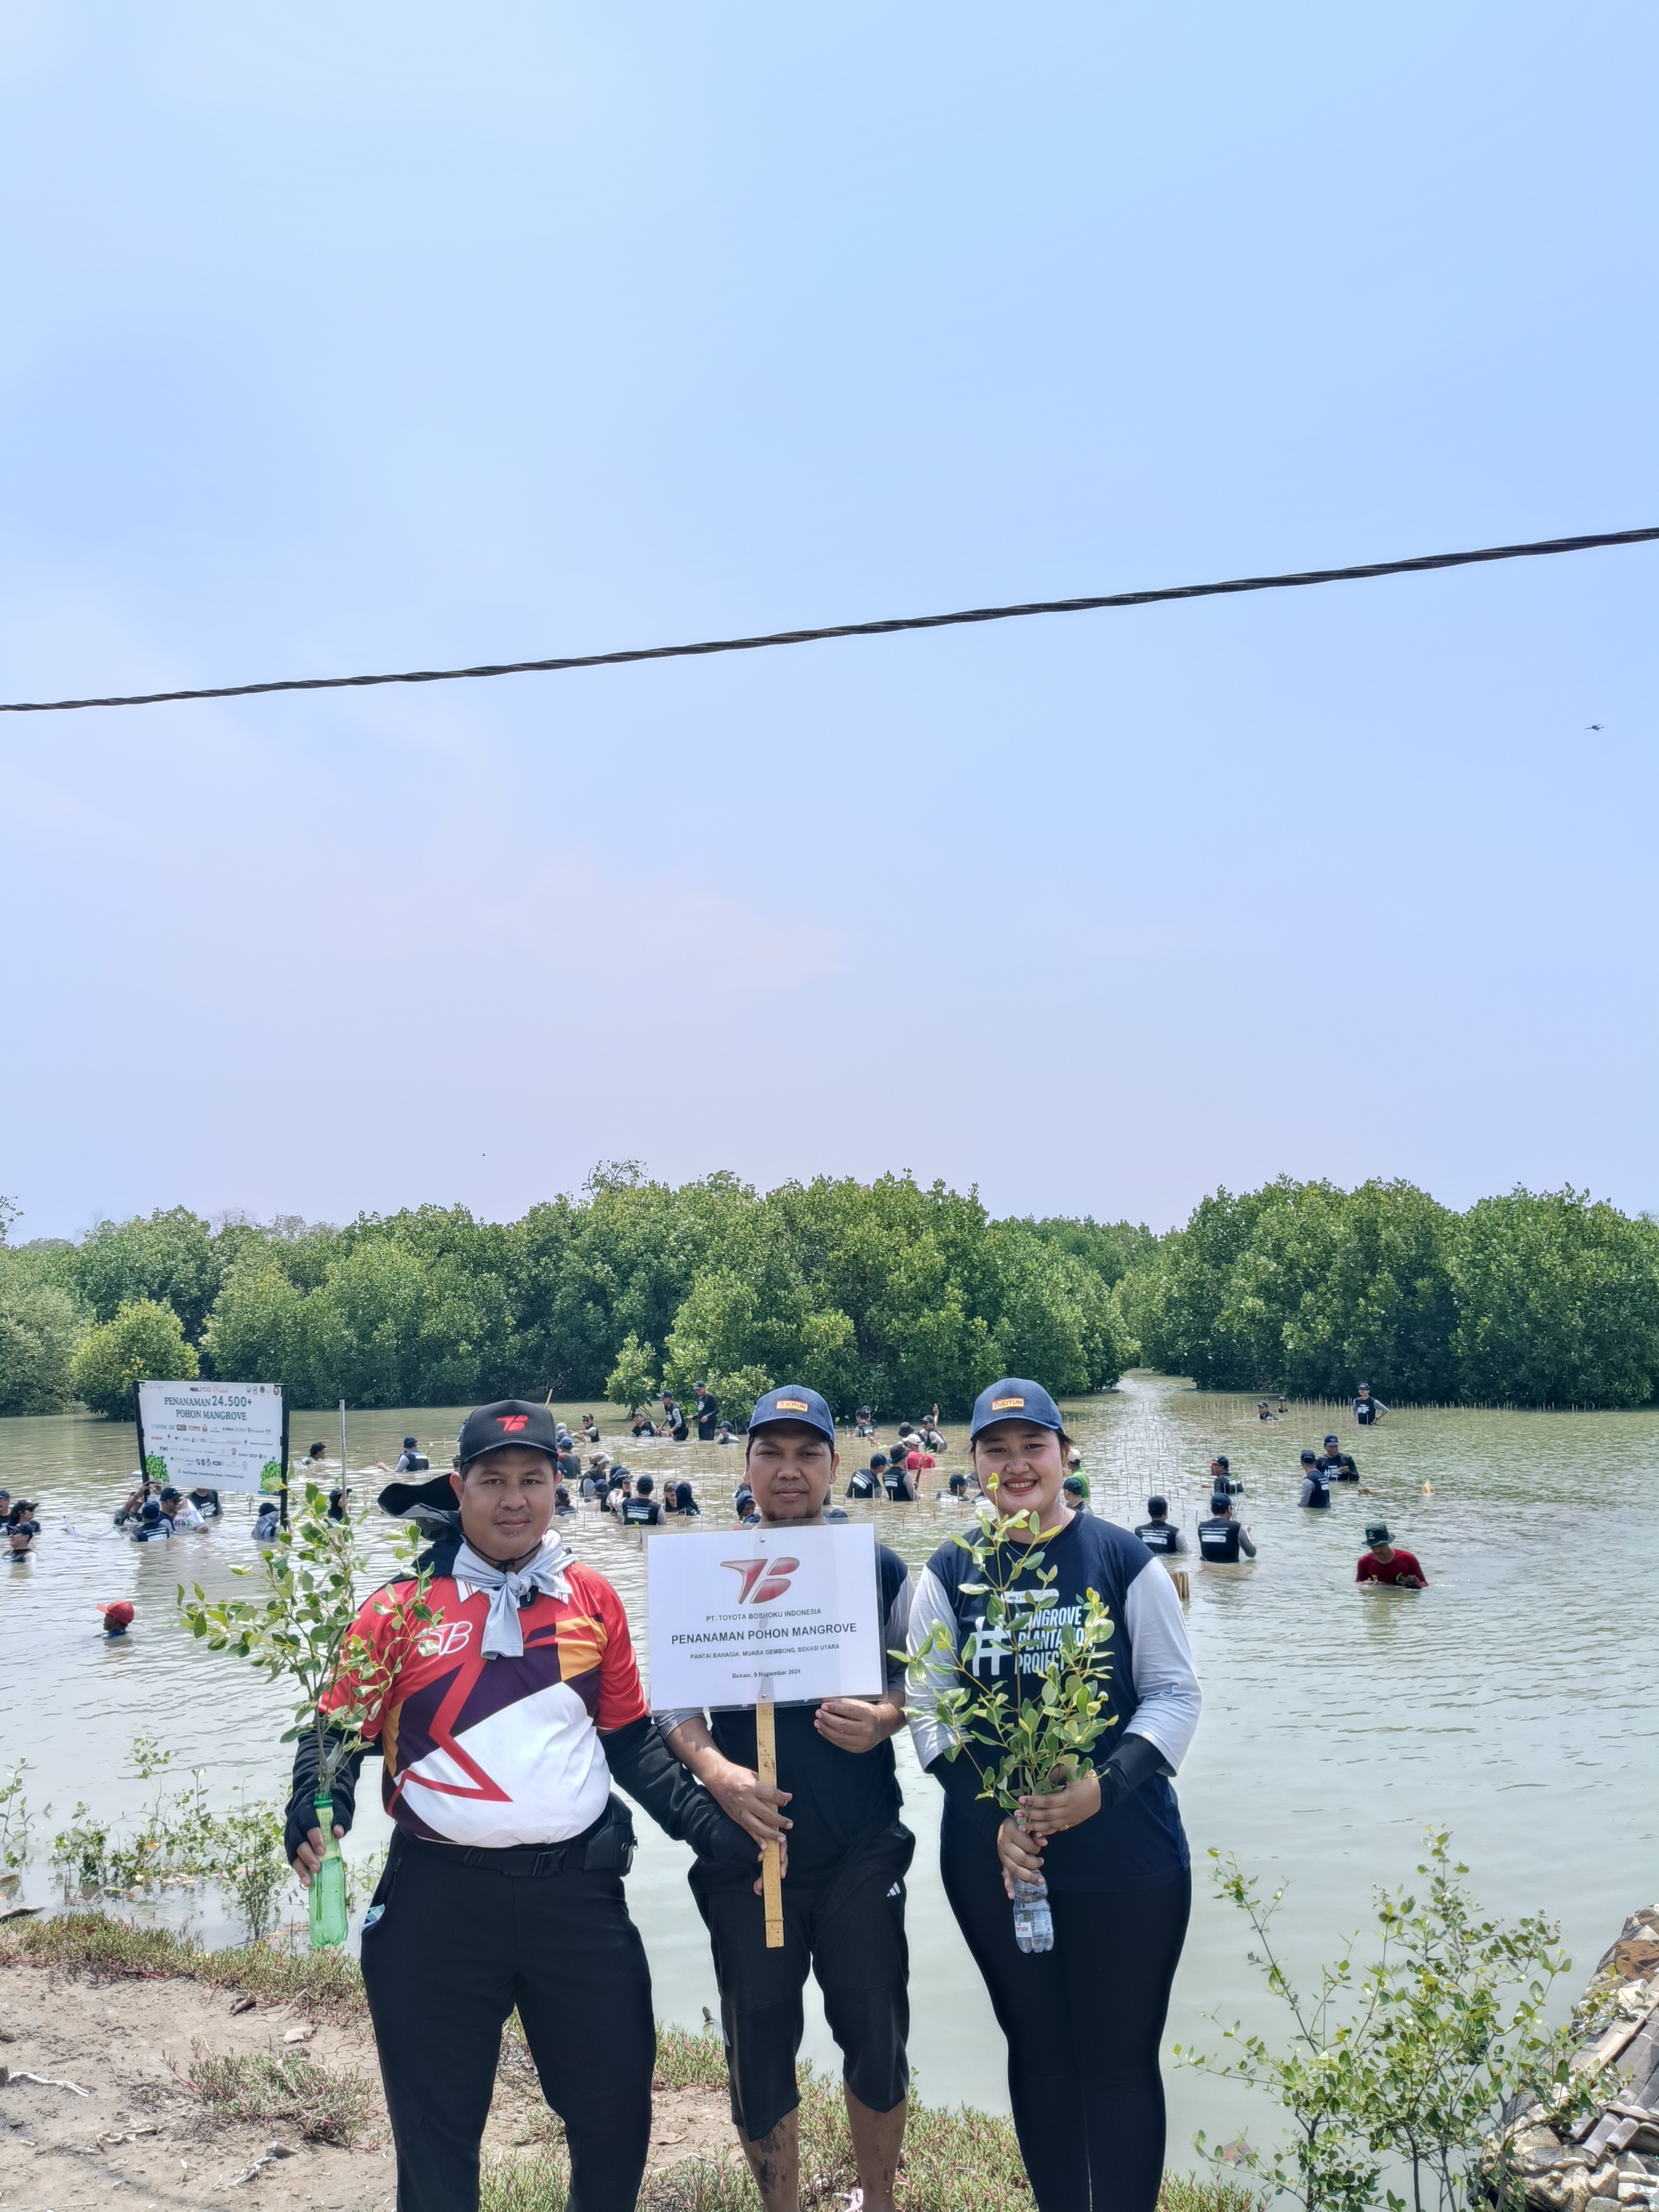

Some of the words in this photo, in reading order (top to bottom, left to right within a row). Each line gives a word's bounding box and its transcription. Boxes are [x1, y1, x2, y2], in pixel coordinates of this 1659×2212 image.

[164, 1397, 211, 1406] PENANAMAN
[211, 1395, 252, 1407] 24.500+
[176, 1409, 201, 1418] POHON
[203, 1410, 247, 1420] MANGROVE
[785, 1608, 821, 1617] INDONESIA
[671, 1631, 744, 1644] PENANAMAN
[748, 1628, 788, 1640] POHON
[792, 1623, 857, 1636] MANGROVE
